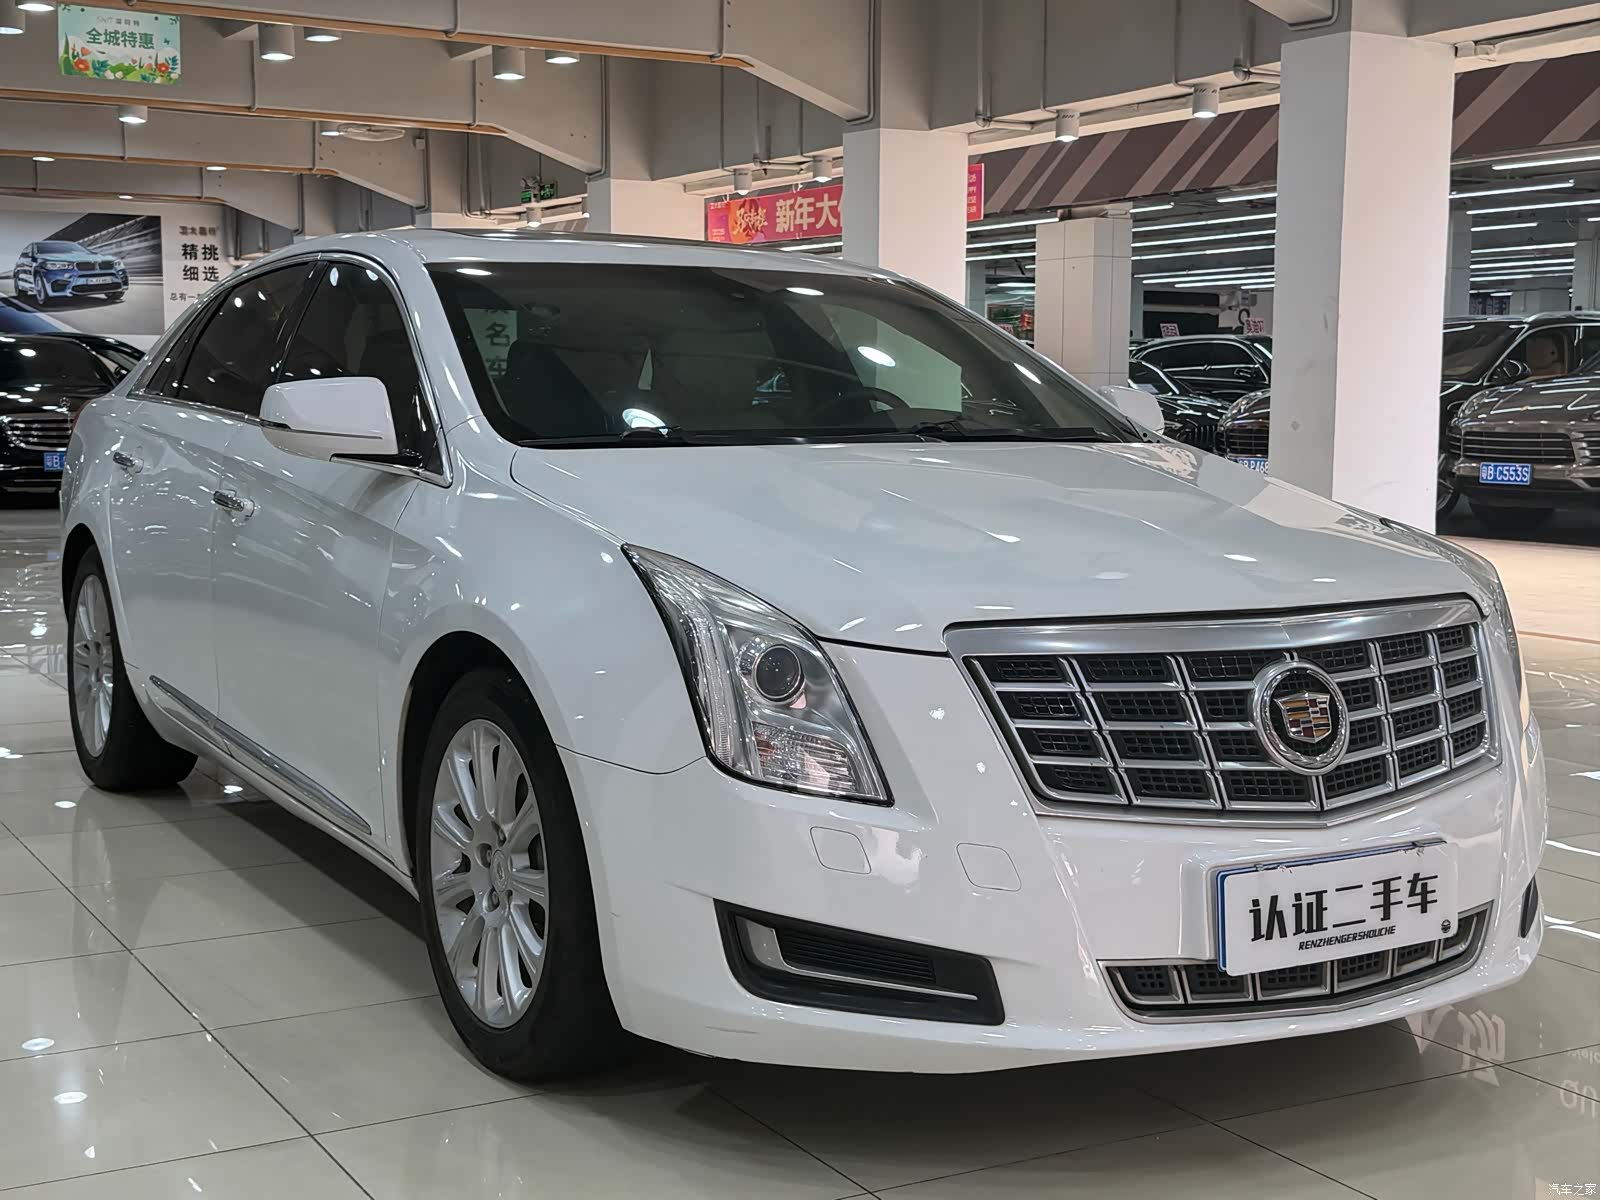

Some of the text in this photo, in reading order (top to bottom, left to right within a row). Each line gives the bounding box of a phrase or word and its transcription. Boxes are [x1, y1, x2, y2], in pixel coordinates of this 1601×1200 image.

[86, 26, 155, 50] 全城特惠
[775, 193, 843, 233] 新年大
[181, 242, 220, 261] 精挑
[182, 265, 220, 282] 细选
[170, 292, 201, 301] 总有一
[1249, 872, 1438, 942] 认证二手车
[1298, 925, 1397, 951] RENZHENGERSHOUCHE
